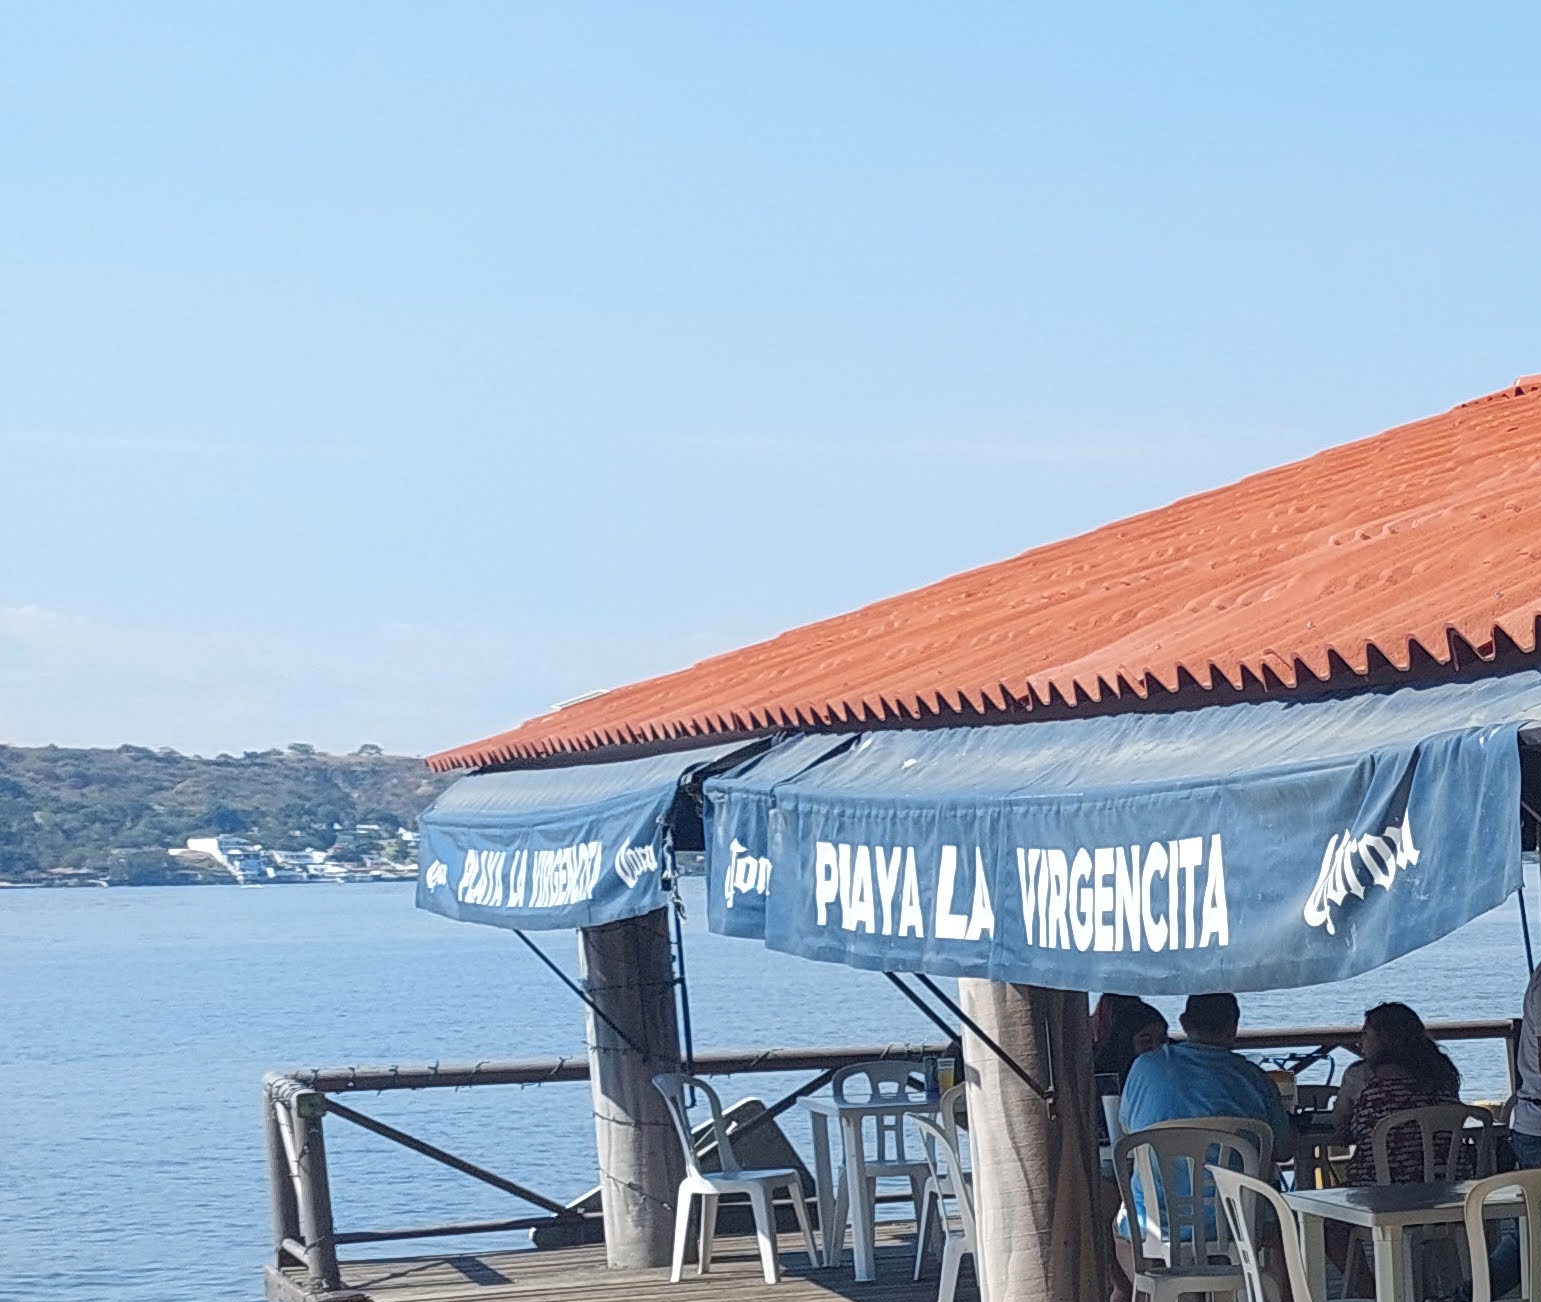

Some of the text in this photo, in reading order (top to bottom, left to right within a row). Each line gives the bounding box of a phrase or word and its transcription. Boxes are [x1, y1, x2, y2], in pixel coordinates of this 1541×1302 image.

[507, 849, 528, 907] LA
[935, 845, 995, 940] LA
[1016, 833, 1229, 952] VIRGENCITA
